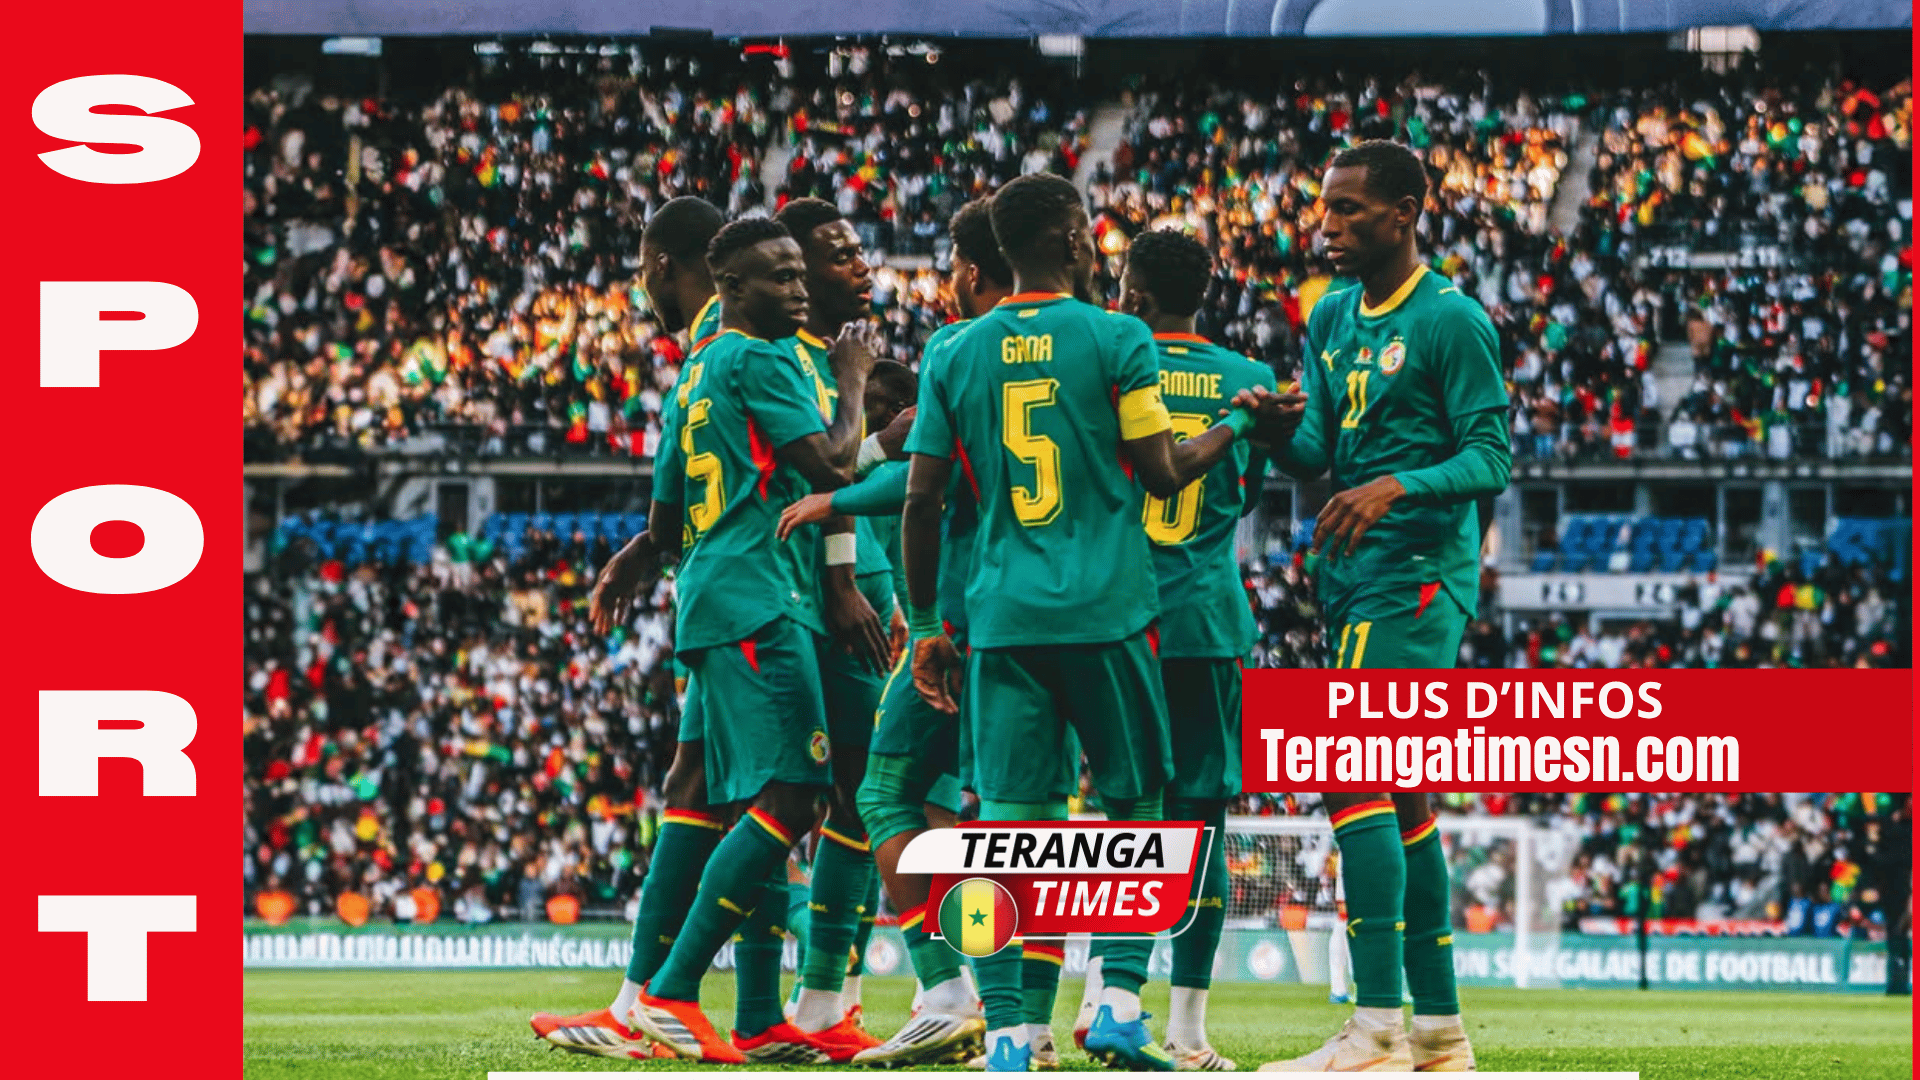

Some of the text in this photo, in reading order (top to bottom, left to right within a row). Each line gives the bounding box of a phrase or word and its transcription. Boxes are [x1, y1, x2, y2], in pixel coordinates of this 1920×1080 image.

[1001, 334, 1053, 364] GANA
[1341, 369, 1371, 429] 11
[681, 398, 727, 548] 5
[1003, 378, 1063, 527] 5
[1665, 951, 1700, 982] DE
[1705, 952, 1837, 984] FOOTBALL
